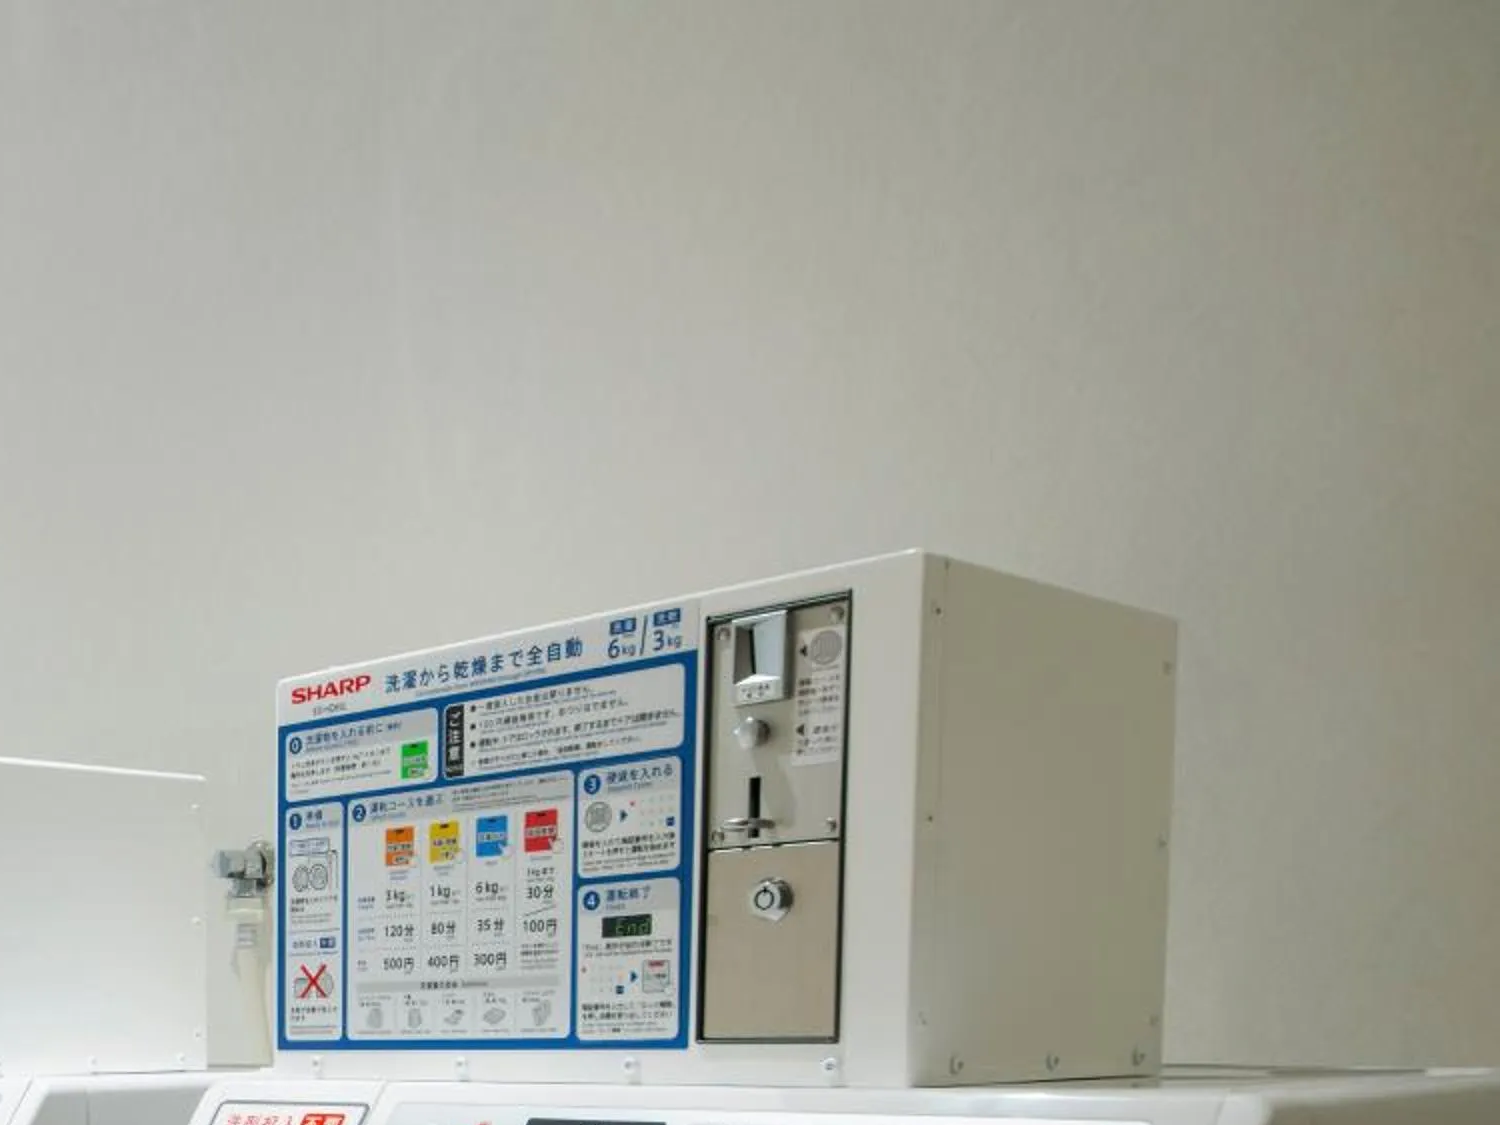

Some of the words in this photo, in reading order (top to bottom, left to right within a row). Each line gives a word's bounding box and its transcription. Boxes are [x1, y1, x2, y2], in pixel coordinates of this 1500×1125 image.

[384, 636, 583, 694] 洗濯から乾燥まで全自動
[291, 674, 371, 705] SHARP
